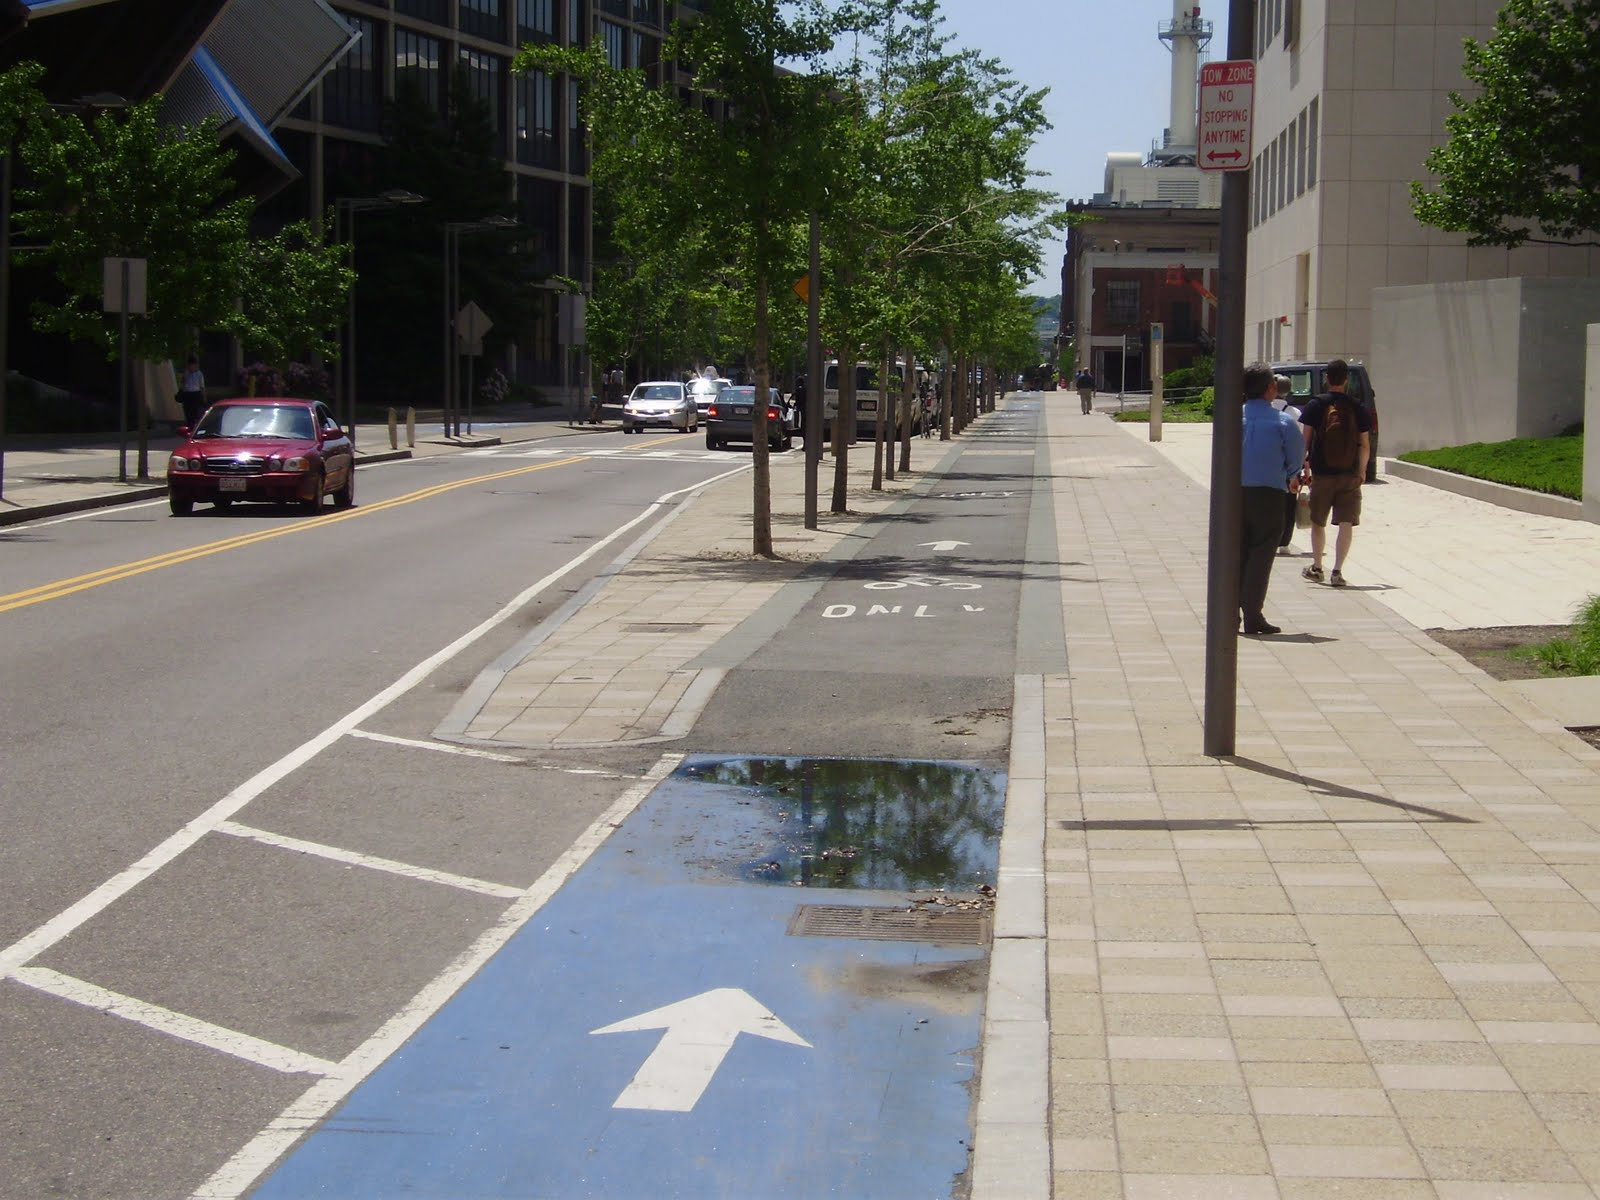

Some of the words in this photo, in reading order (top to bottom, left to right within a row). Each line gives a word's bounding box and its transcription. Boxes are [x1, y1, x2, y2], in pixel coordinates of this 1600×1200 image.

[1203, 69, 1223, 83] TOW
[1227, 67, 1253, 82] ZONE
[1218, 90, 1234, 103] NO
[1204, 109, 1247, 124] STOPPING
[1204, 129, 1246, 144] ANYTIME
